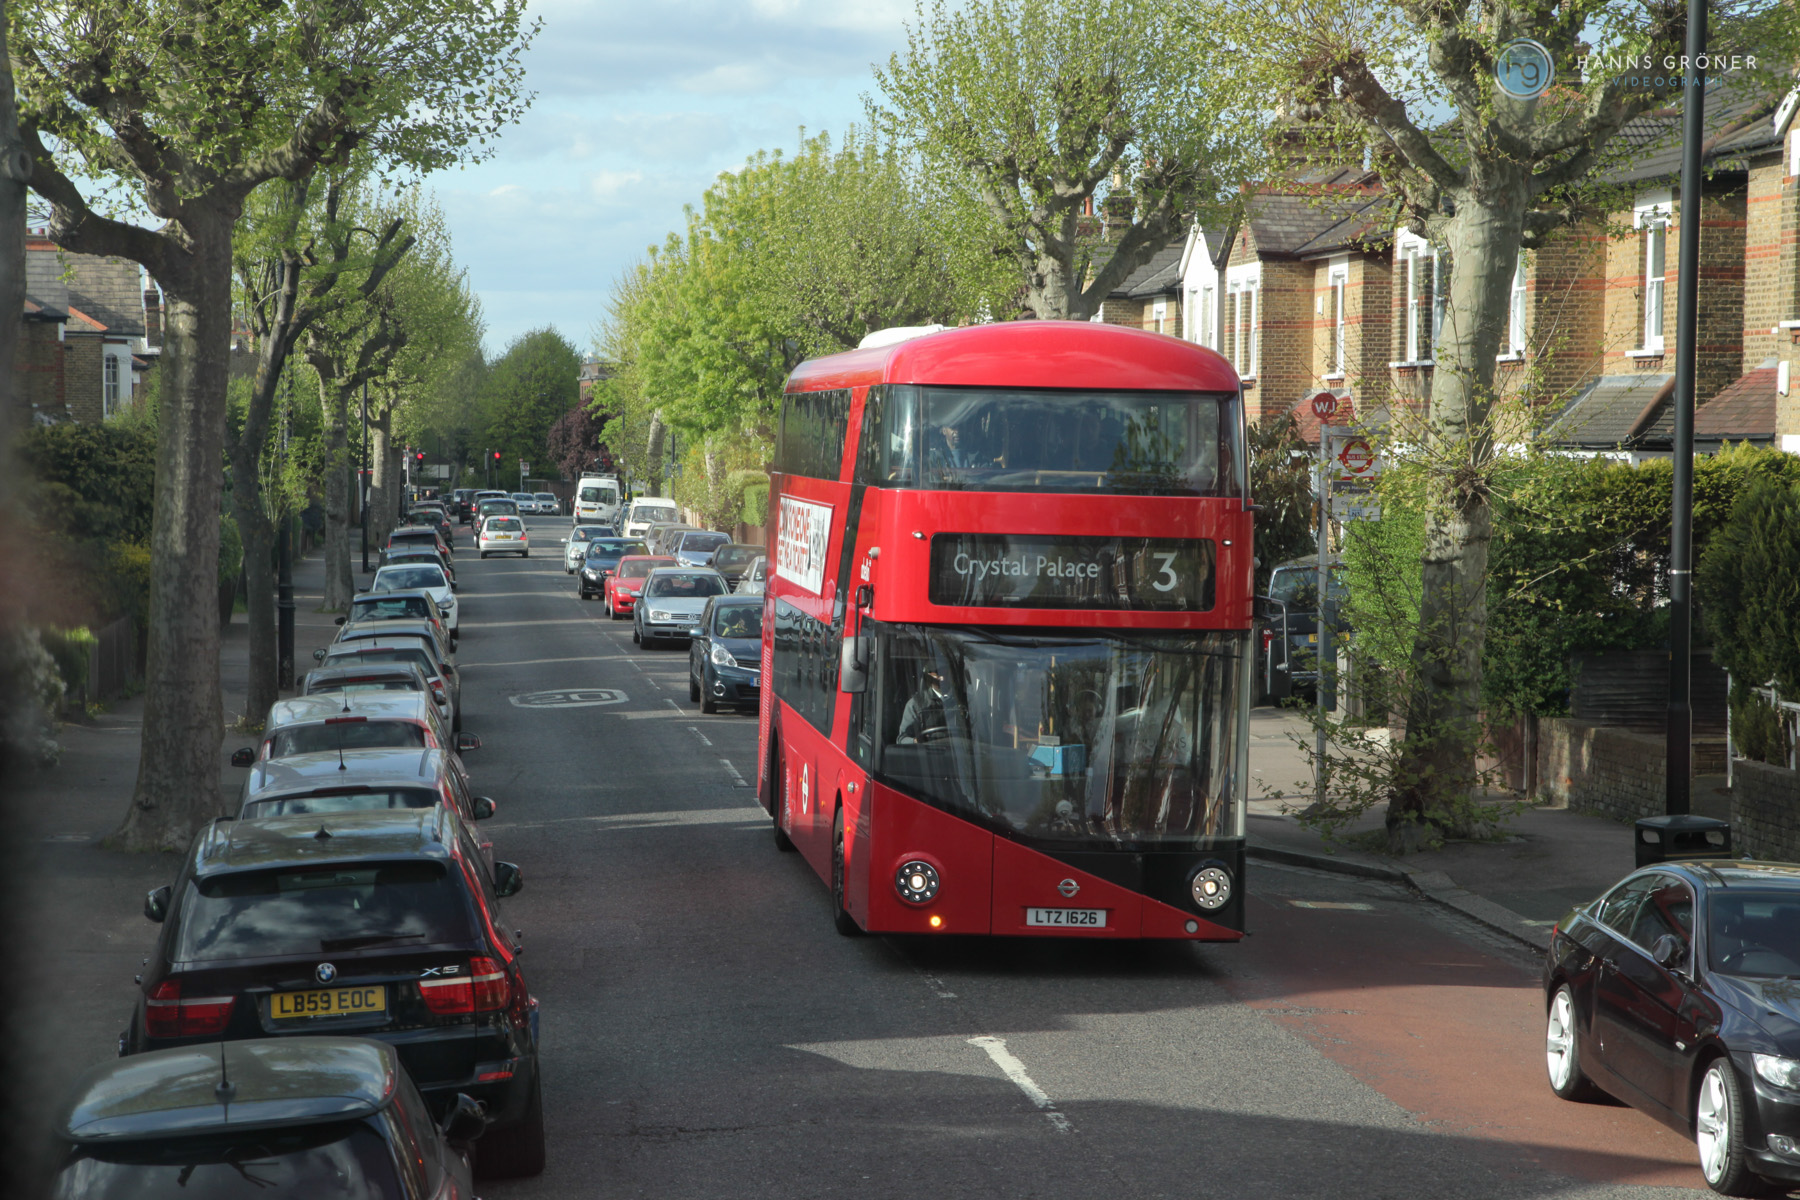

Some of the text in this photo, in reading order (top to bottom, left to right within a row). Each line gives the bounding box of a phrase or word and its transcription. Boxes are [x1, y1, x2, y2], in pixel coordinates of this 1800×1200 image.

[1315, 401, 1336, 413] WJ
[953, 552, 1178, 592] Crystal Palace 3
[527, 692, 612, 704] 20
[1035, 910, 1097, 925] LTZ 1626
[420, 965, 460, 977] X5
[279, 990, 376, 1014] LB59 EOC
